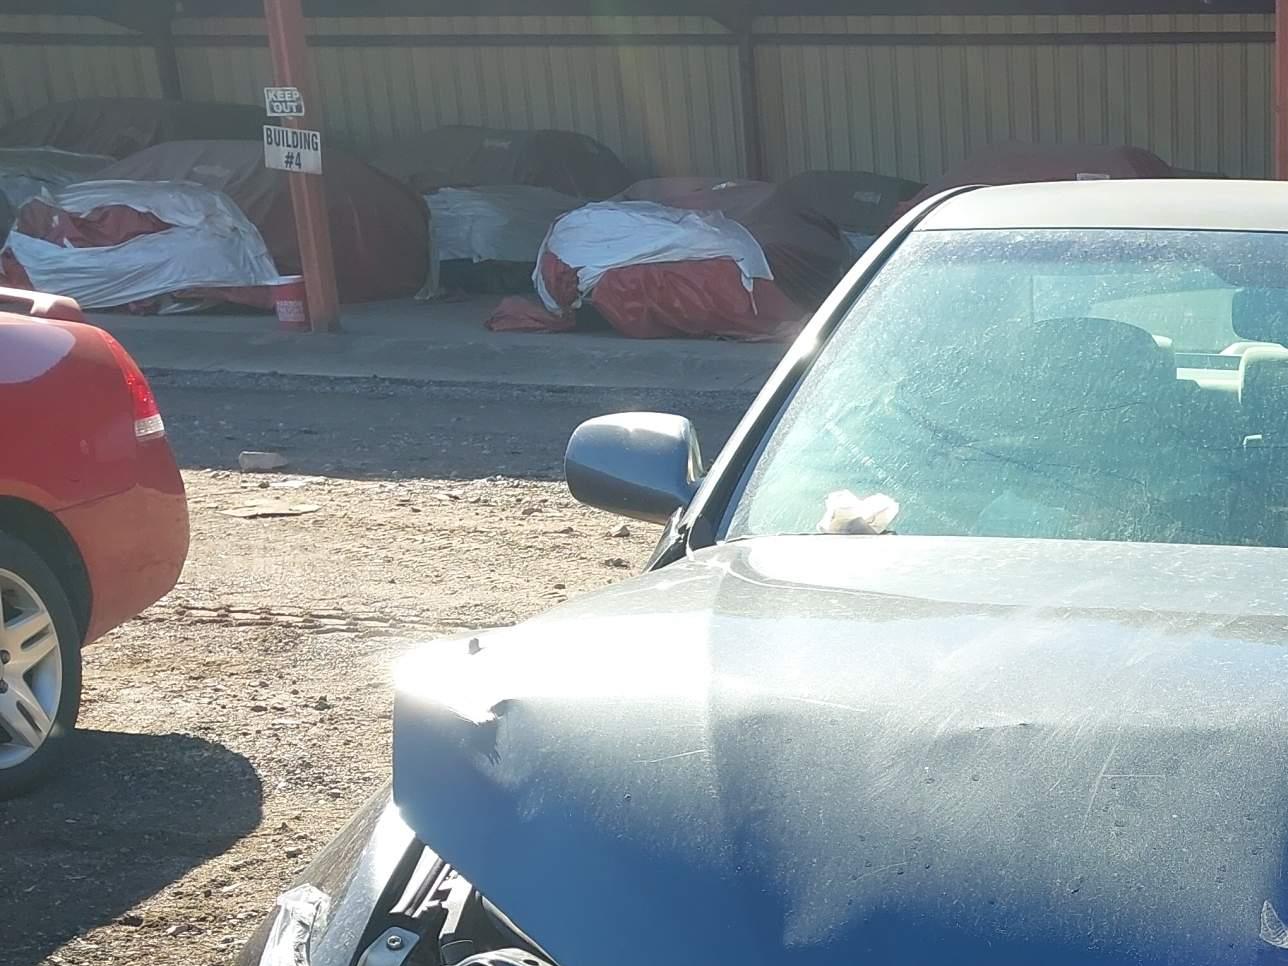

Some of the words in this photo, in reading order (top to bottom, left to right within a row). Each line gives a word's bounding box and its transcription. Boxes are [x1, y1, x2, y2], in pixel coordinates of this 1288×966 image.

[268, 90, 299, 101] KEEP
[272, 102, 298, 113] OUT
[266, 127, 319, 151] BUILDING
[284, 151, 302, 169] #4
